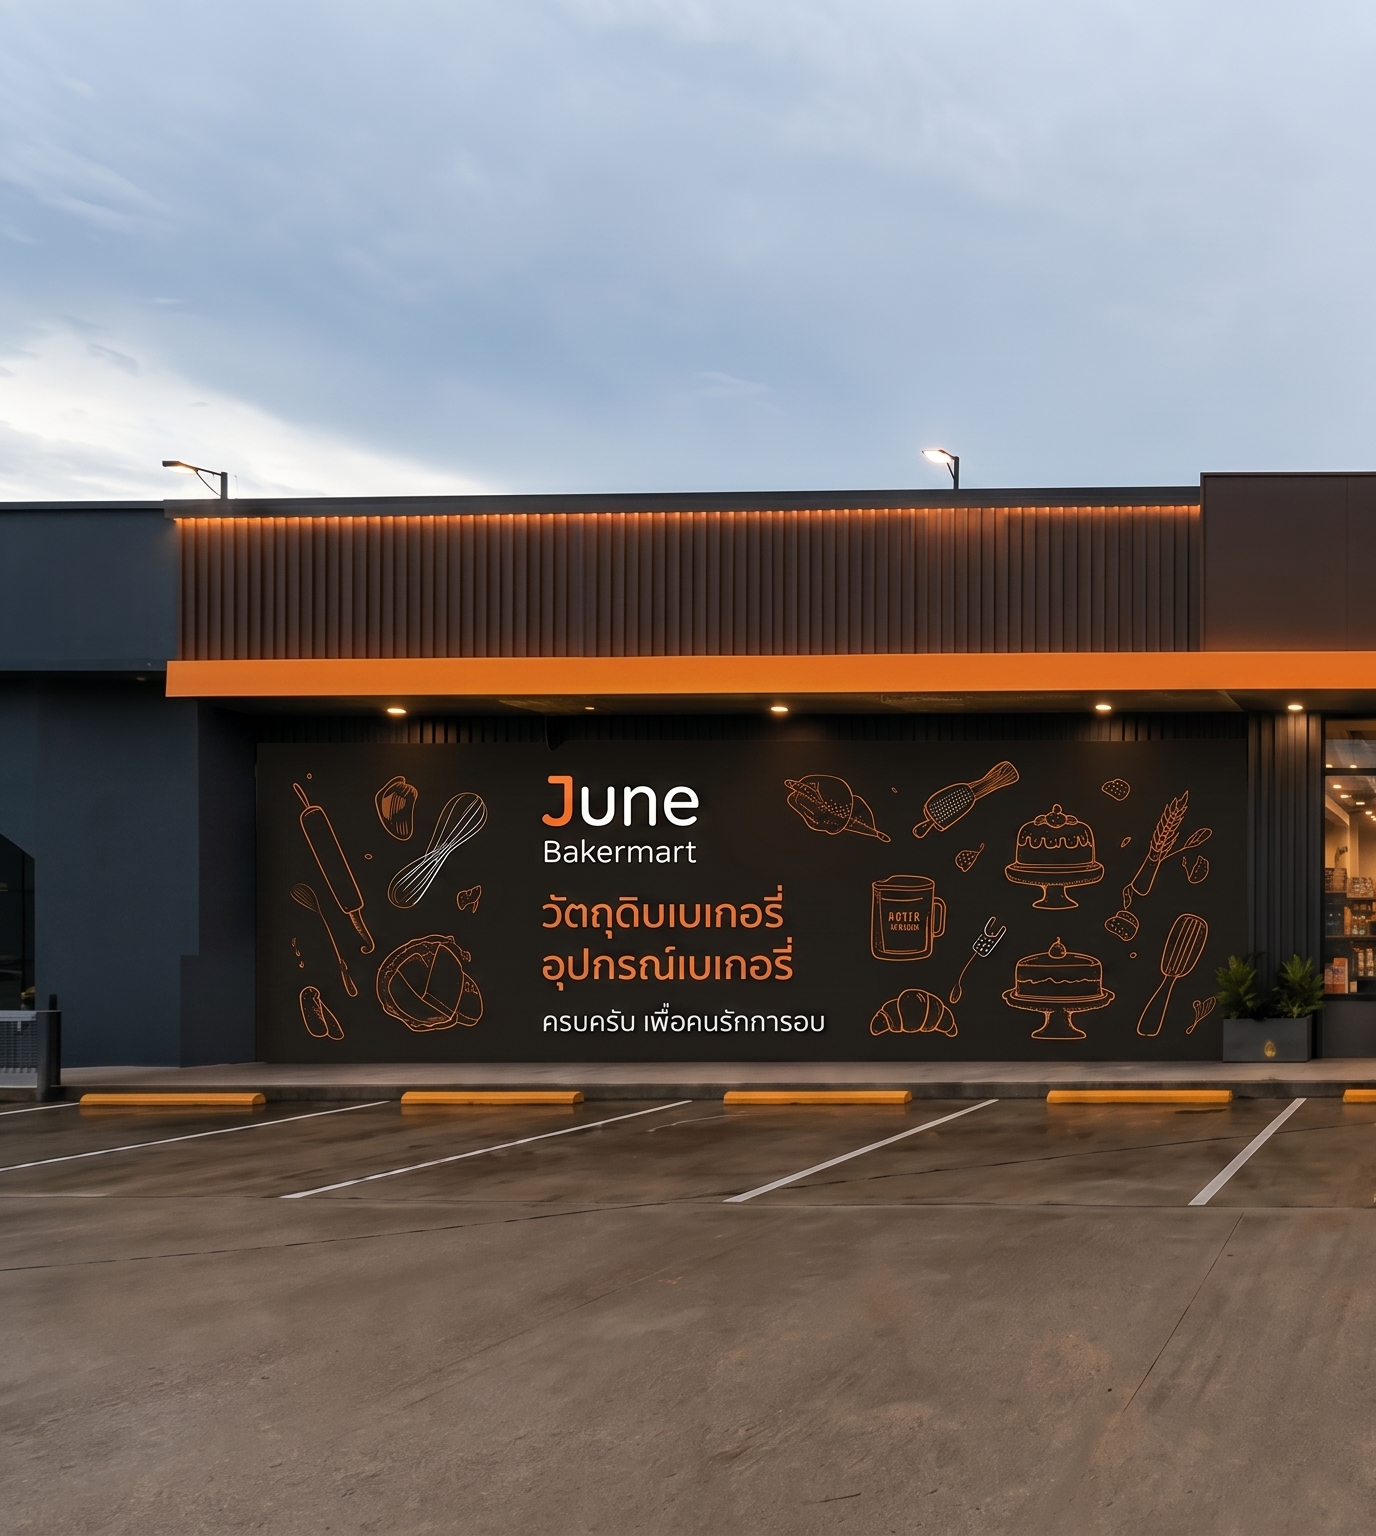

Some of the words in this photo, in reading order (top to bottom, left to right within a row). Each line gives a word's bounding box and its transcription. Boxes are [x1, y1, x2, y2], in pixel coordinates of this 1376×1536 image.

[541, 775, 700, 827] June
[543, 838, 697, 864] Bakermart
[542, 884, 784, 939] วัตถุดิบเบเกอรี่
[542, 936, 794, 992] อุปกรณ์เบเกอรี่
[543, 1008, 635, 1032] ครบครัน
[644, 1002, 825, 1032] เพื่อคนรักการอบ
